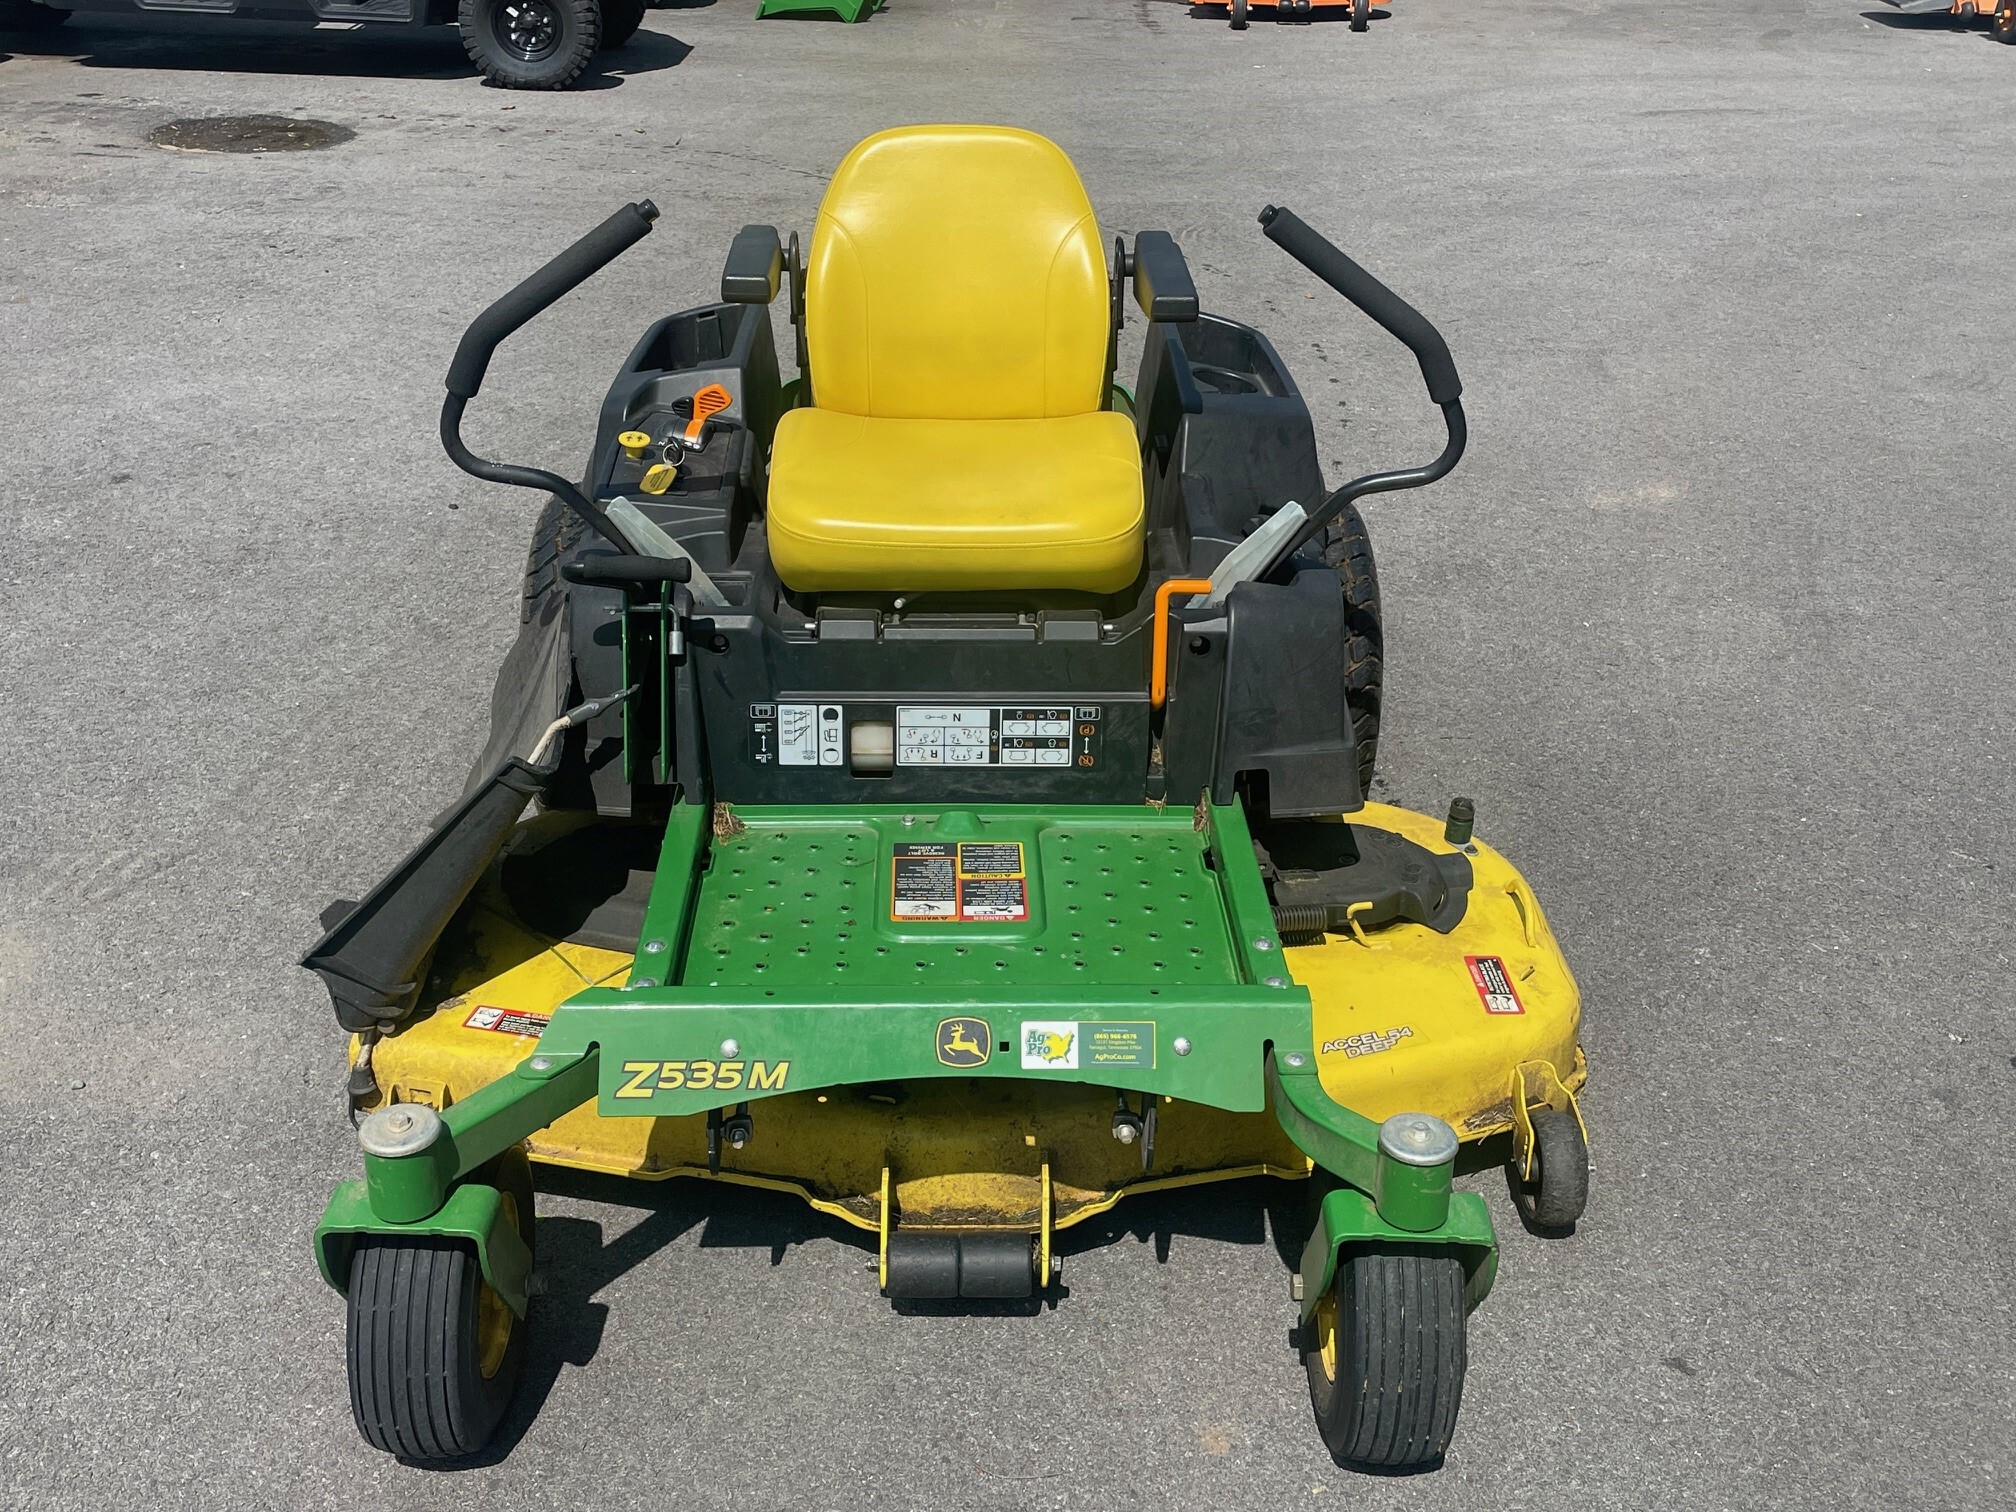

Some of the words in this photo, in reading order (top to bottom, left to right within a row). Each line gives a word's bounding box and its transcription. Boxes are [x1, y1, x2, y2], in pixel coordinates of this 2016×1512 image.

[953, 713, 961, 722] N
[930, 750, 938, 760] R
[976, 751, 983, 760] F
[1026, 1029, 1051, 1045] Ag-
[1322, 1031, 1387, 1054] ACCEL
[1386, 1026, 1414, 1041] 54
[1026, 1043, 1051, 1056] Pro
[1345, 1038, 1398, 1059] DEEP
[1094, 1053, 1136, 1061] AgProCo.com
